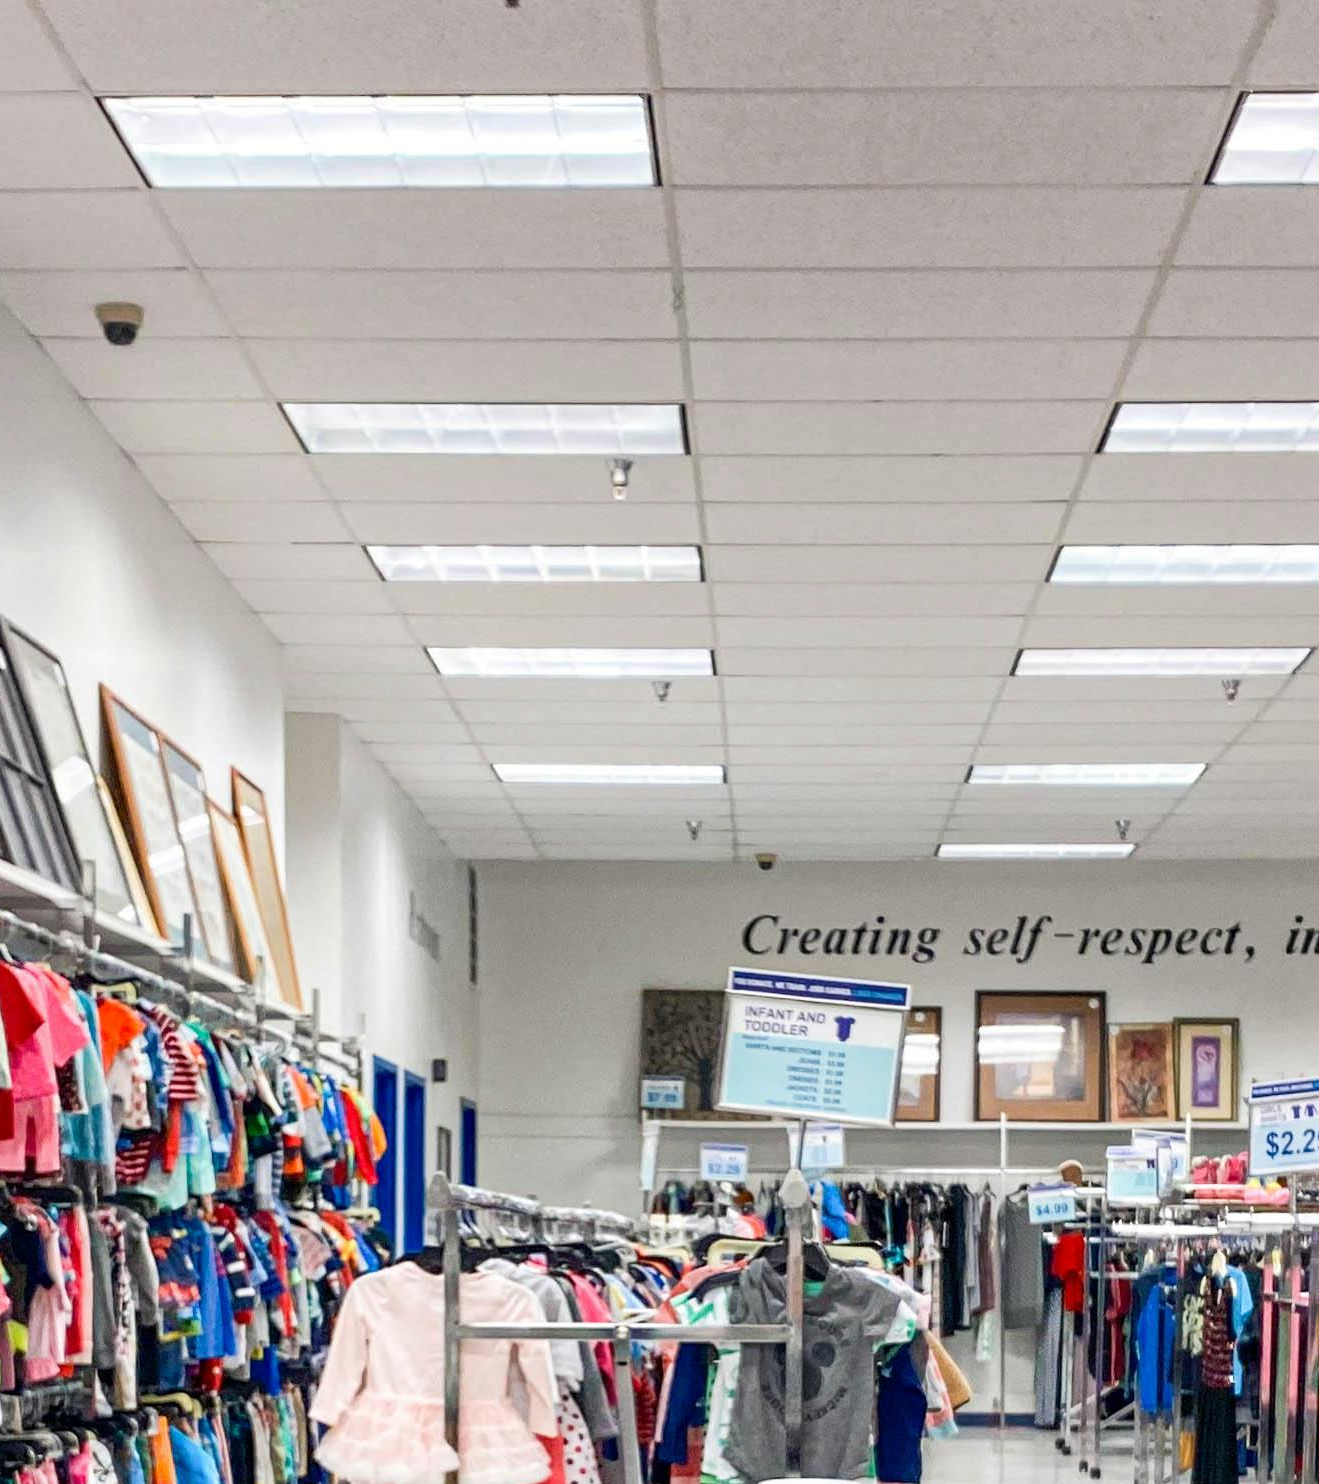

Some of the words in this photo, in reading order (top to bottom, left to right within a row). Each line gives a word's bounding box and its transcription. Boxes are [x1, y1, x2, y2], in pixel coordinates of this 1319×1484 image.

[742, 914, 941, 964] Creating
[963, 915, 1256, 965] self-respect,
[744, 1005, 794, 1021] INFANT
[799, 1012, 826, 1024] AND
[744, 1019, 809, 1036] TODDLER
[1035, 1202, 1069, 1217] $4.99
